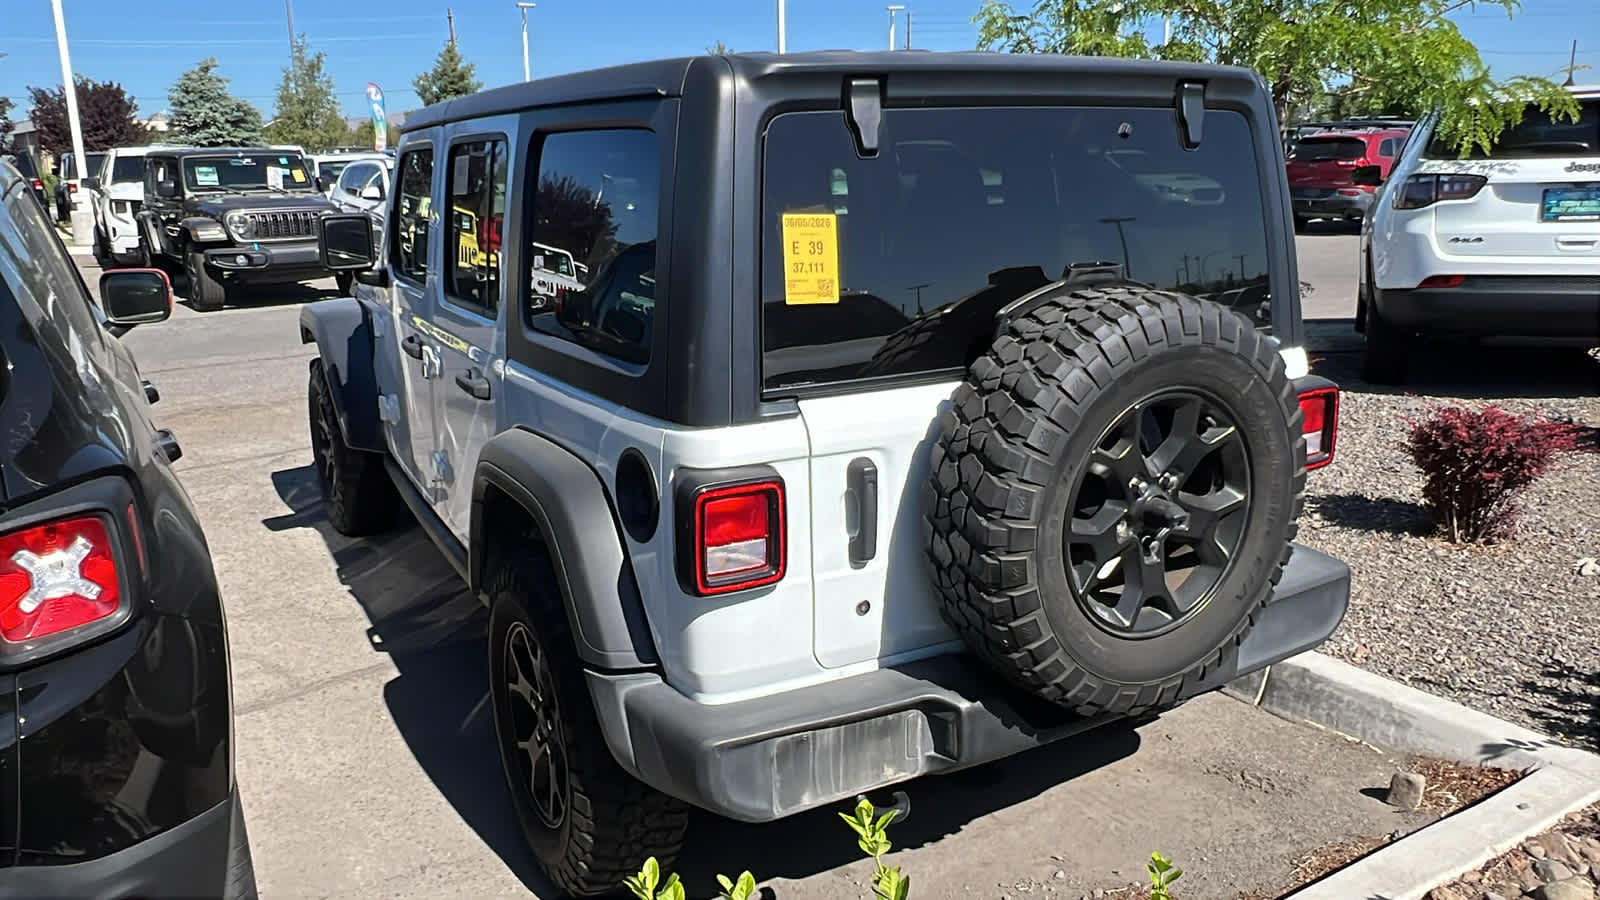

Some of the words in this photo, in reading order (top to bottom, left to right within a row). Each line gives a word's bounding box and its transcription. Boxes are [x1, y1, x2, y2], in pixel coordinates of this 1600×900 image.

[792, 241, 800, 255] E
[809, 241, 823, 255] 39
[793, 262, 824, 273] 37,111
